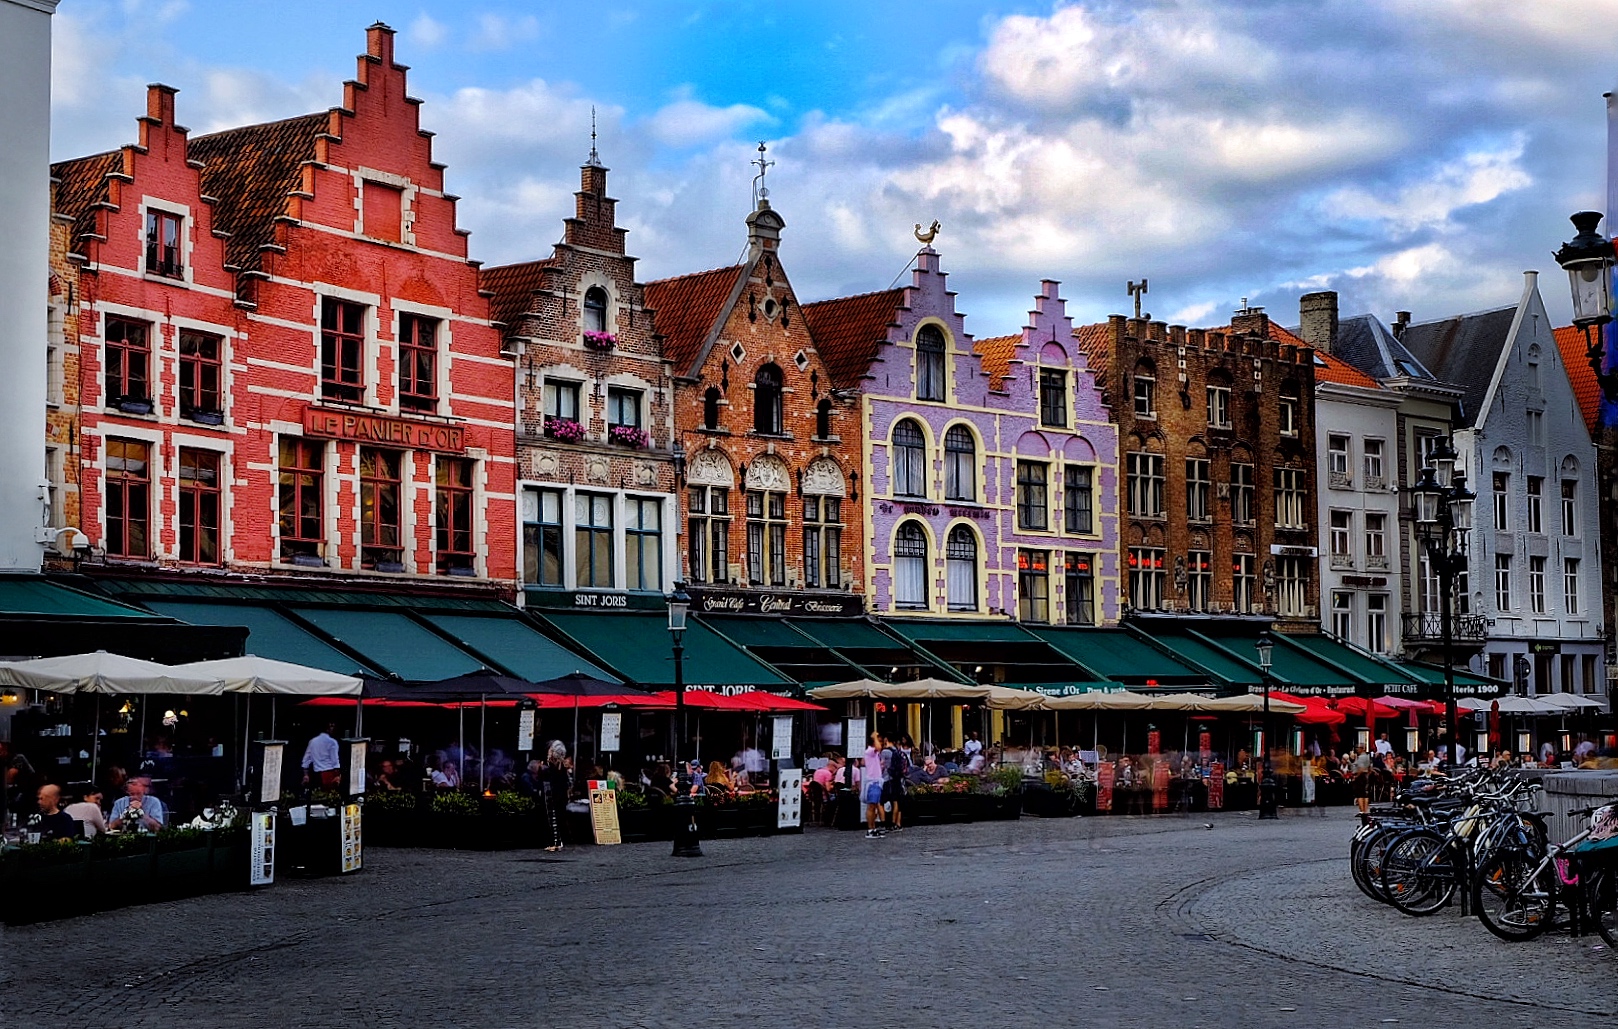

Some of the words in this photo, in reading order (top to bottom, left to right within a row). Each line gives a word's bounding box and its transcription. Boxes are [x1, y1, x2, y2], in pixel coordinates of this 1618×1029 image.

[312, 415, 338, 435] LE
[343, 415, 413, 445] PANIER
[575, 594, 598, 606] SINT
[600, 595, 627, 607] JORIS
[703, 596, 728, 612] Grand
[760, 594, 792, 612] Central
[805, 600, 843, 612] Brasserie
[716, 684, 756, 697] JORIS
[1248, 684, 1277, 693] Brassrie
[1384, 684, 1401, 693] PETIT
[1477, 684, 1499, 694] 1900
